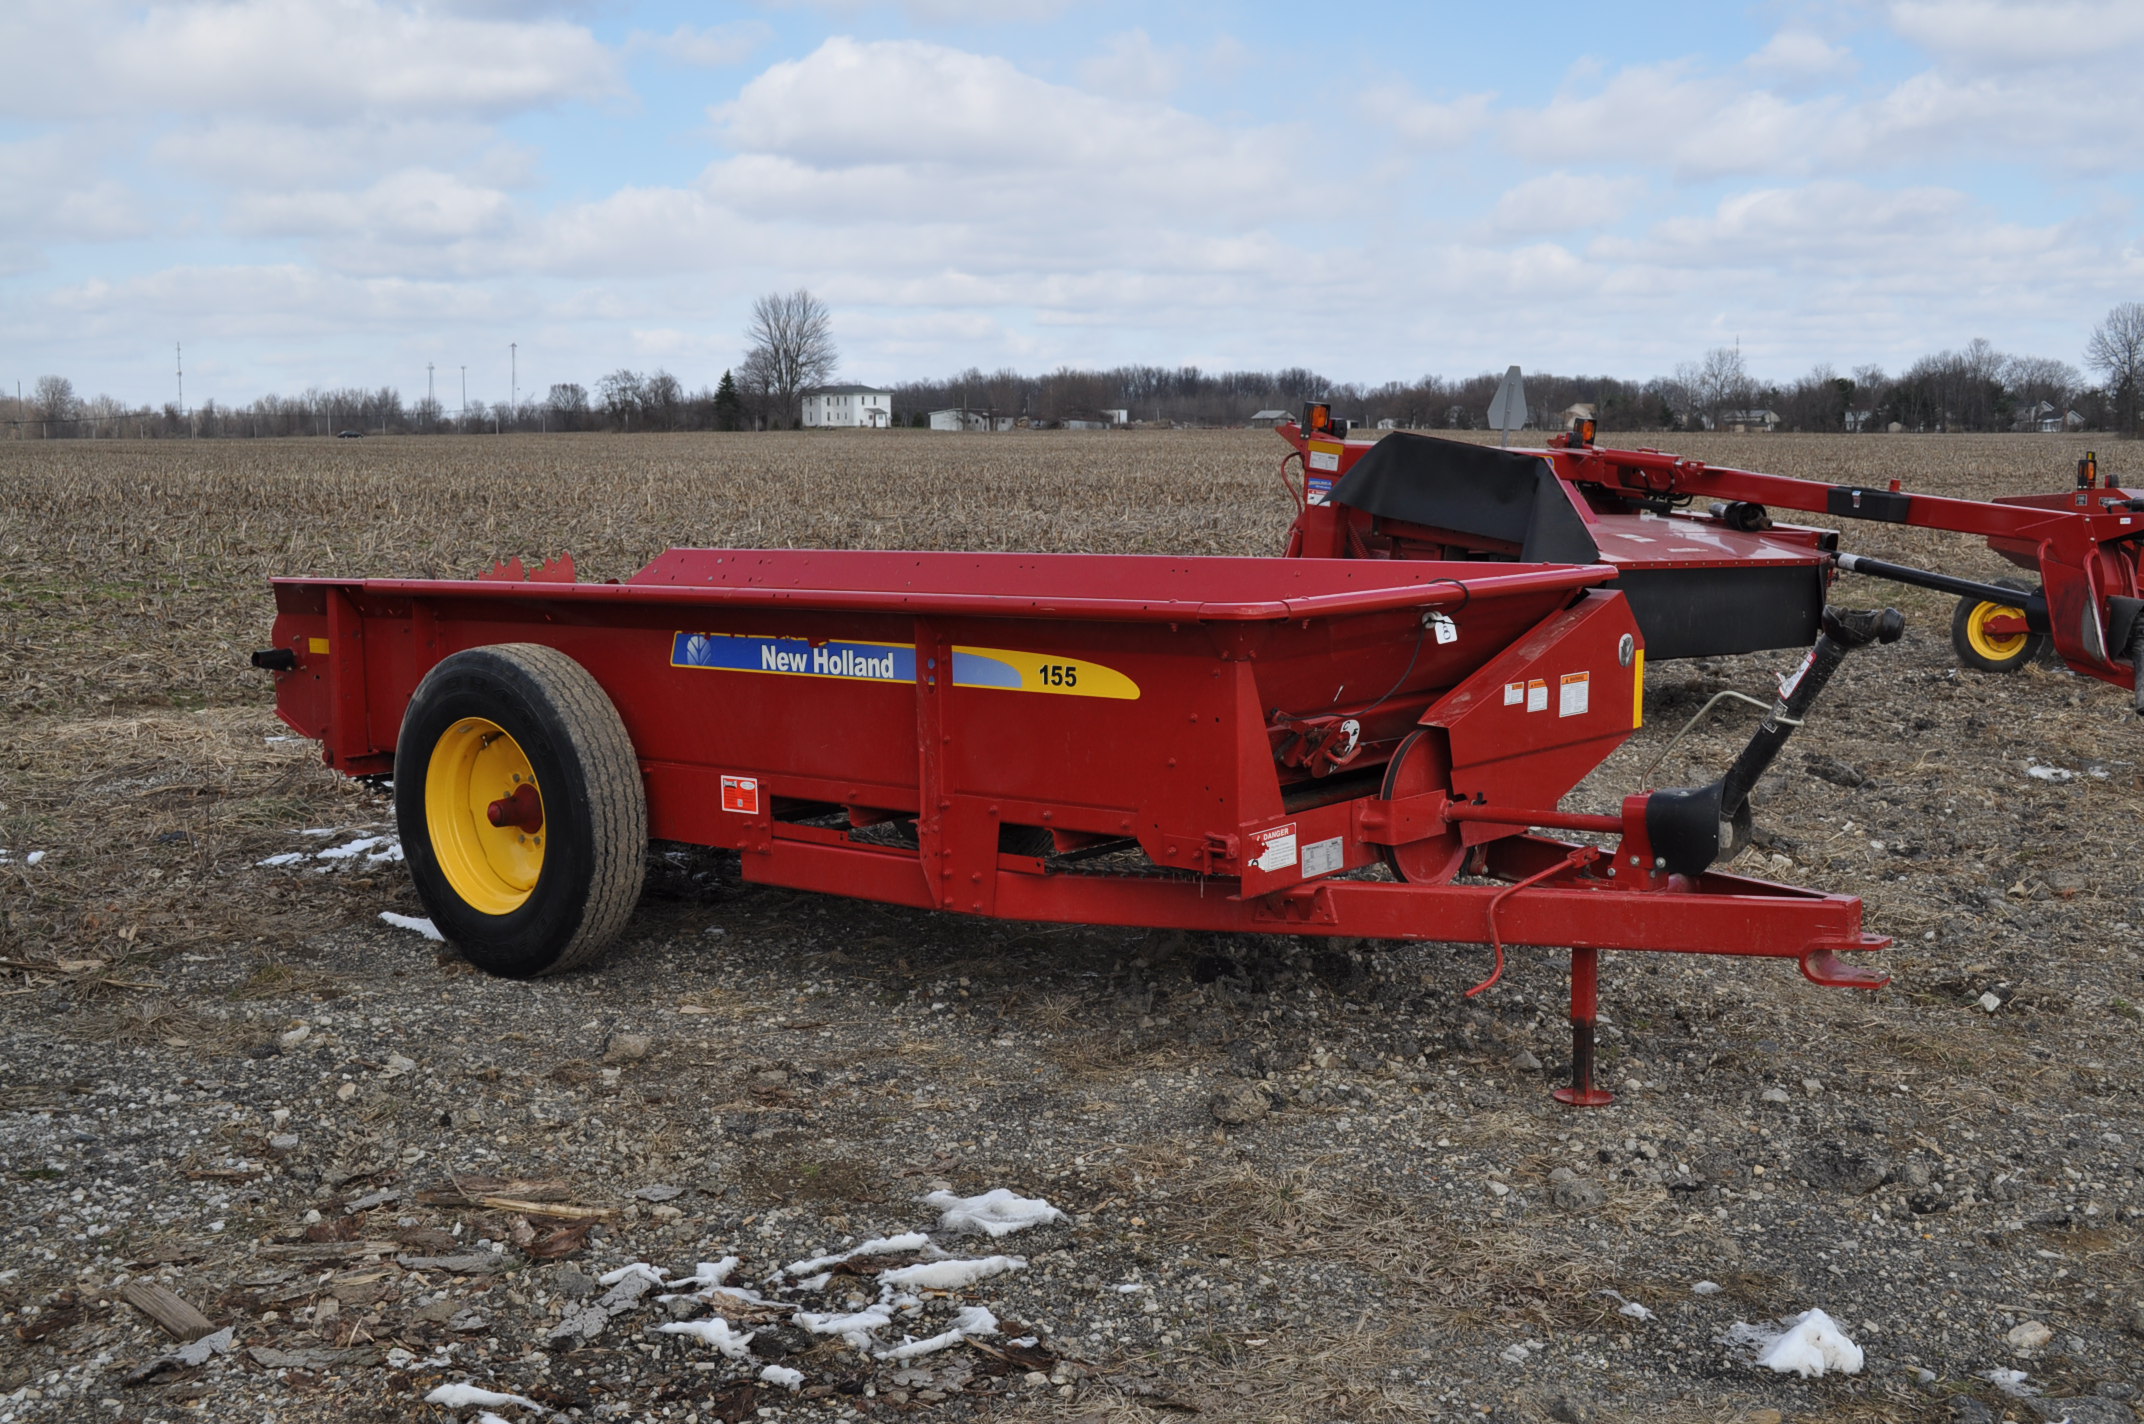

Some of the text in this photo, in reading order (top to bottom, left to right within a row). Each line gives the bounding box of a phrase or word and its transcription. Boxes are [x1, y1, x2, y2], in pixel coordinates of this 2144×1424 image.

[761, 645, 894, 679] New Holland
[1039, 664, 1077, 687] 155
[1263, 827, 1289, 841] DANGER
